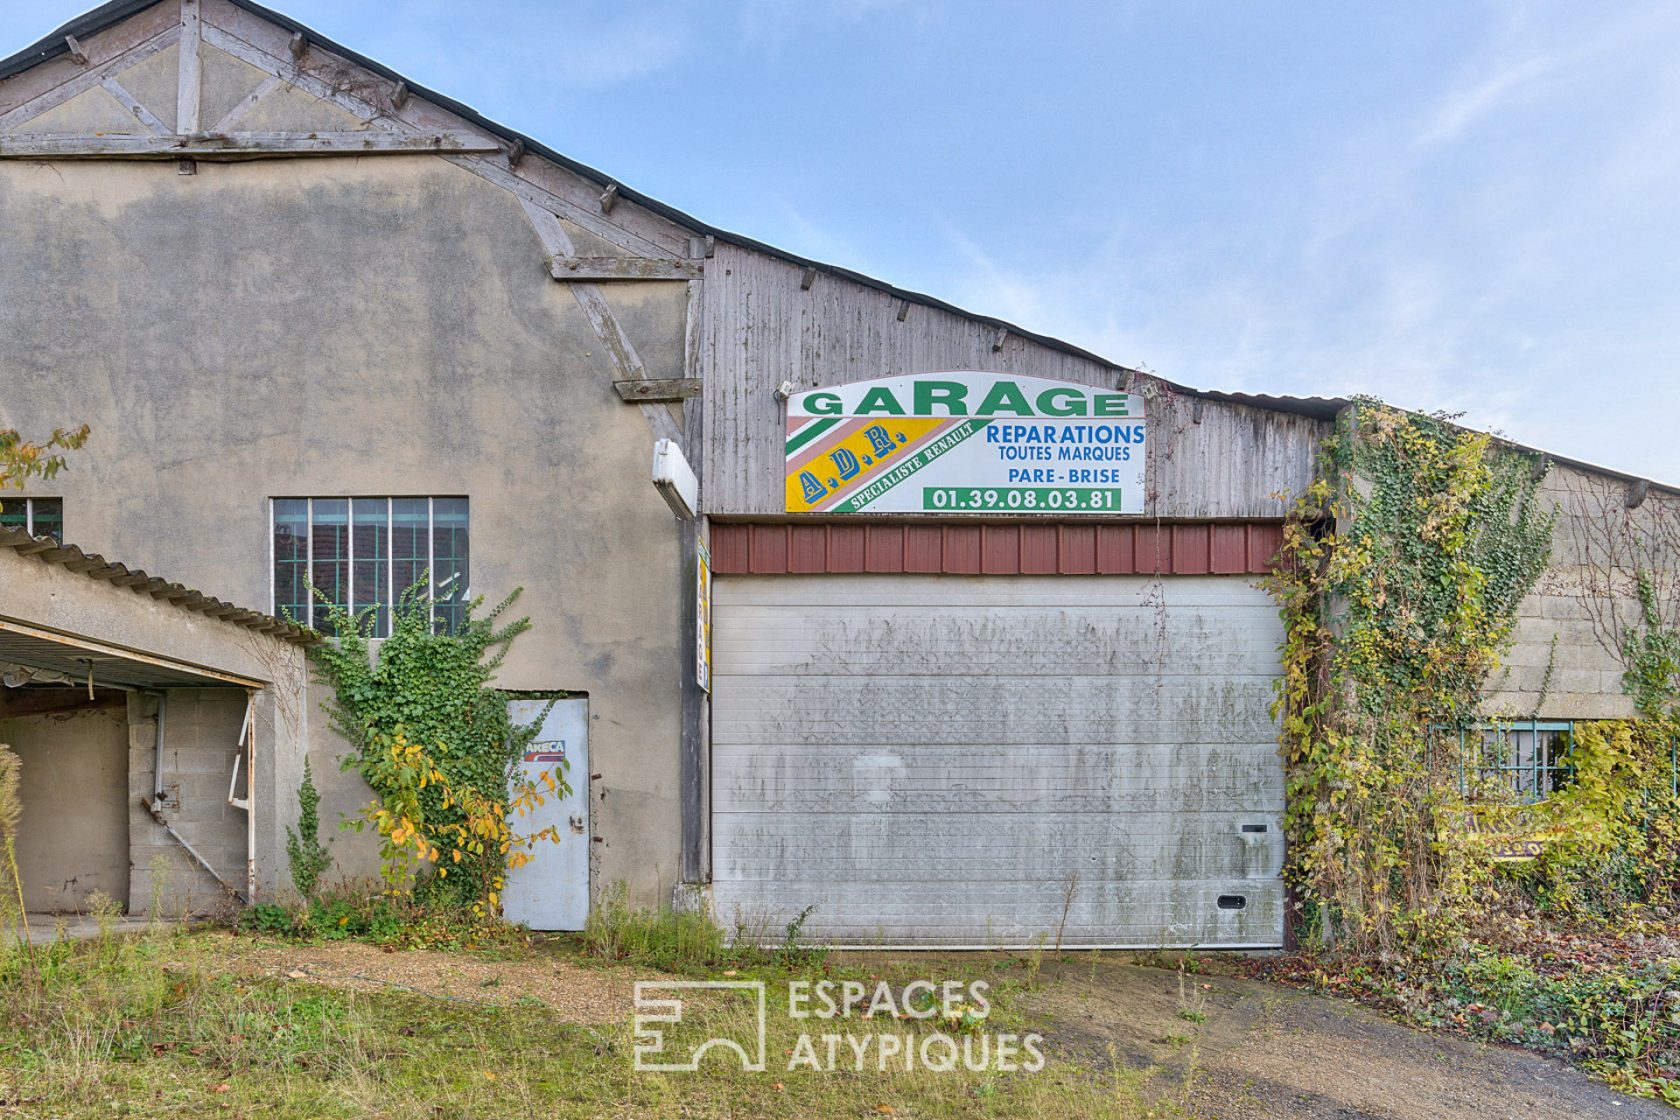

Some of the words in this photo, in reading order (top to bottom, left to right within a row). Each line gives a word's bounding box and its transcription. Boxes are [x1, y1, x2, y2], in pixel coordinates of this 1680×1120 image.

[803, 380, 1129, 417] GARAGE
[986, 425, 1145, 444] REPARATIONS
[799, 425, 907, 504] A.D.R.
[851, 456, 922, 509] SPECIALISTE
[923, 422, 974, 461] RENAULT
[999, 446, 1052, 461] TOUTES
[1058, 446, 1131, 461] MARQUES
[932, 490, 1114, 508] 01.39.08.03.81
